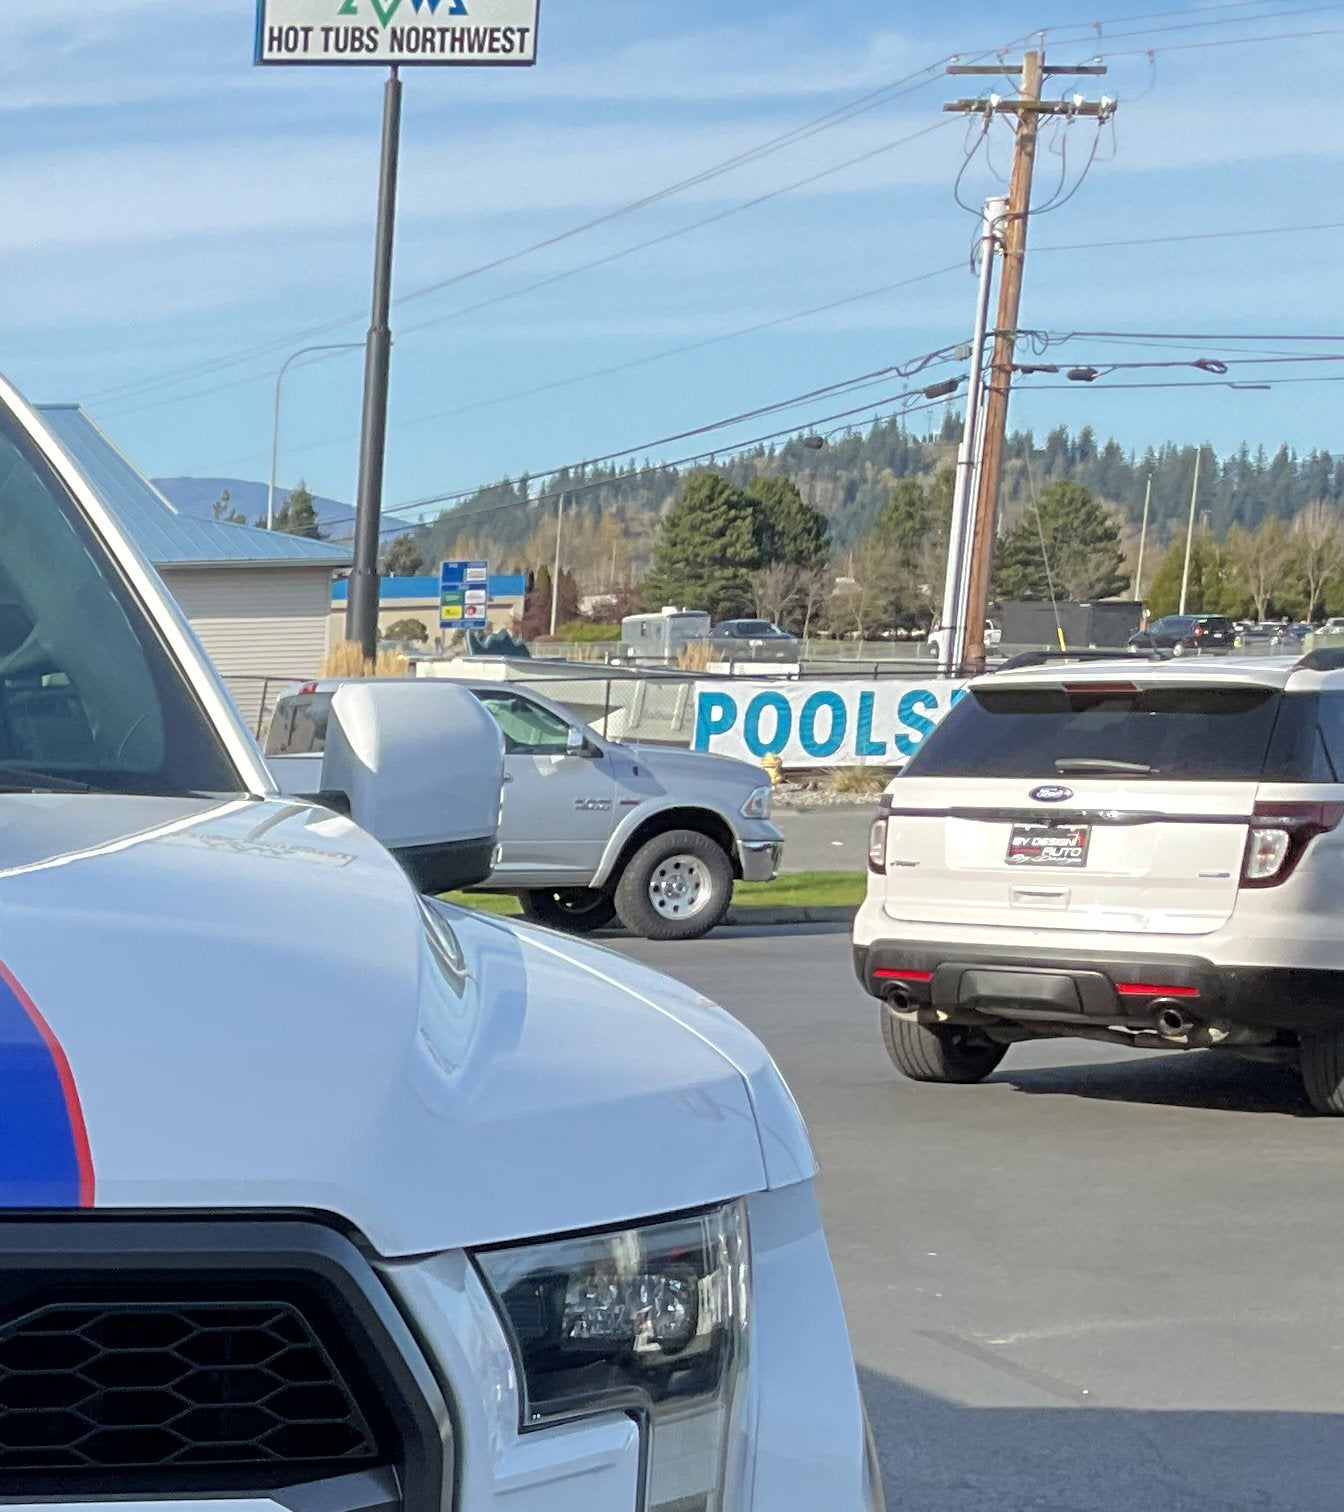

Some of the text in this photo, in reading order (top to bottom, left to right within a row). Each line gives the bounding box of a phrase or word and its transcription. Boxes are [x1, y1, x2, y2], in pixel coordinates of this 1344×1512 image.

[268, 26, 530, 54] HOT TUBS NORTHWEST
[1041, 846, 1083, 857] AUTO
